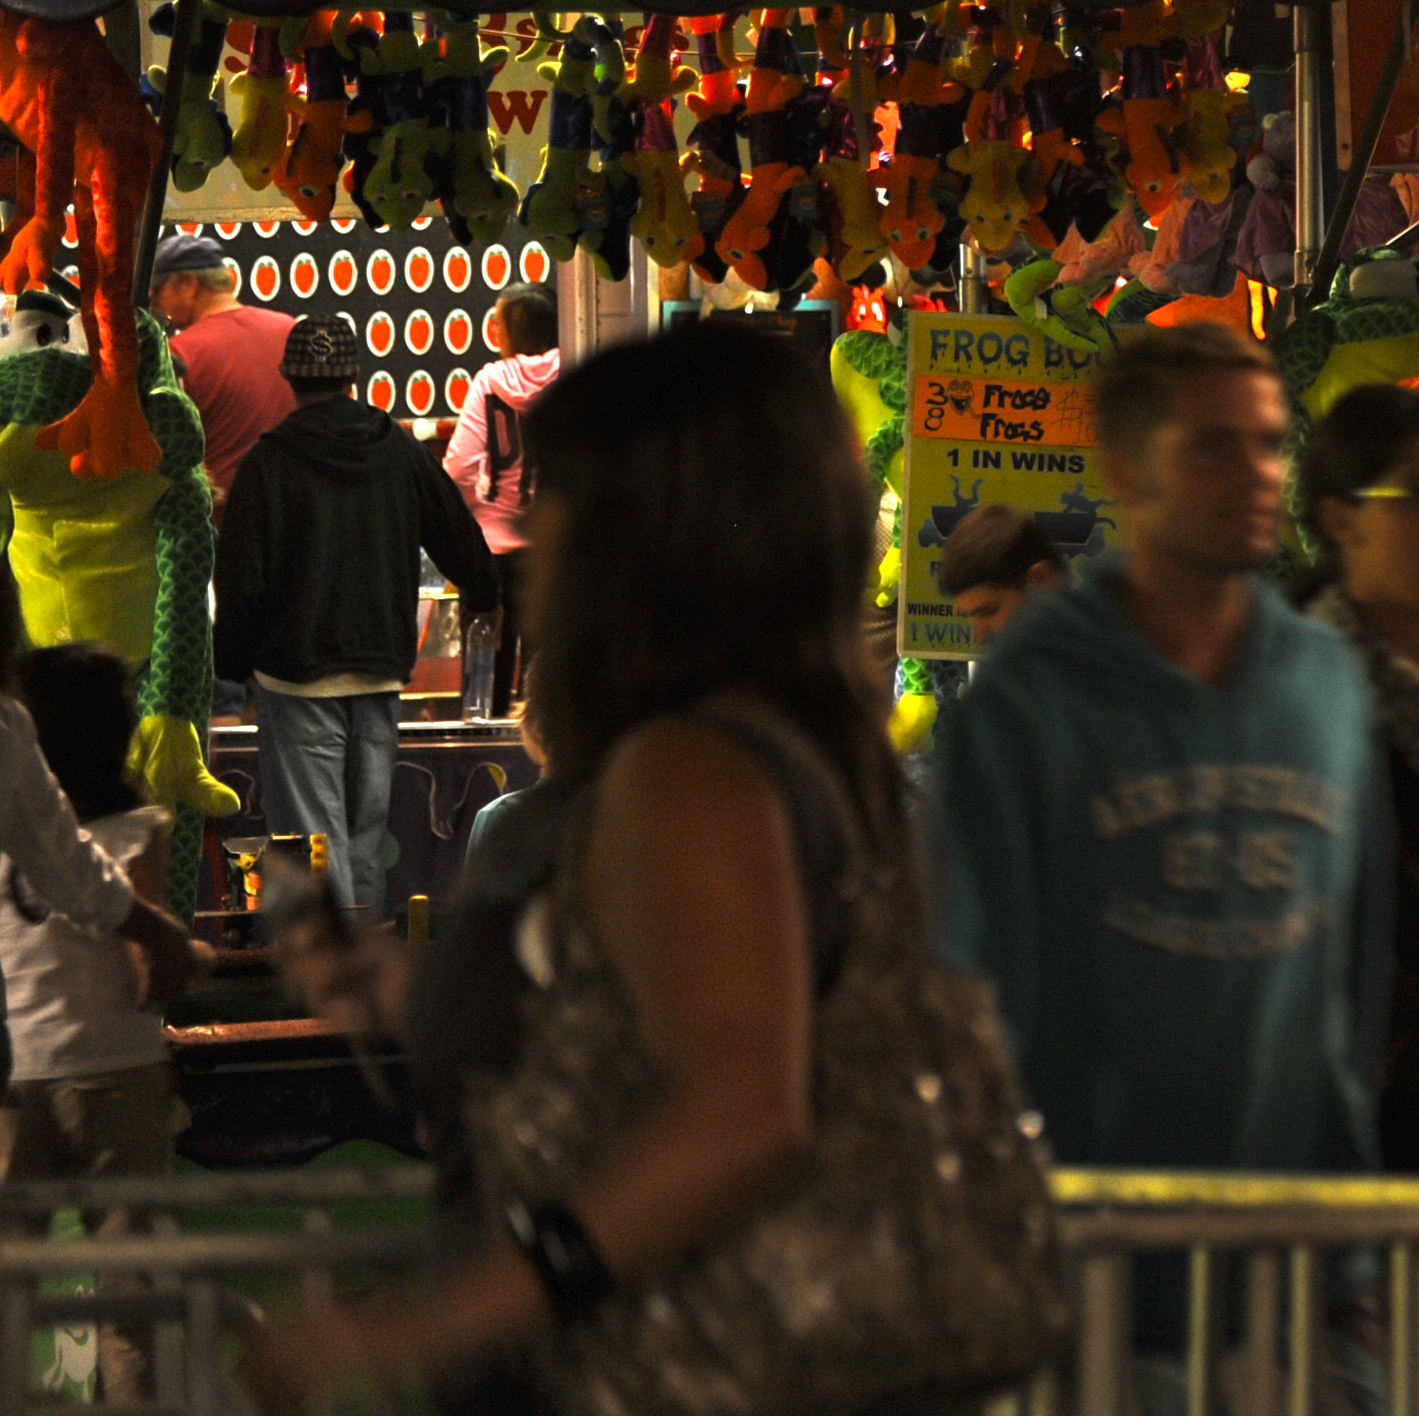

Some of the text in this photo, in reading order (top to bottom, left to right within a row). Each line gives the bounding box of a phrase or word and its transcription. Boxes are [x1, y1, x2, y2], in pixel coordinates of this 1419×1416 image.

[929, 329, 1031, 372] FROG
[926, 382, 948, 406] 3
[924, 407, 945, 431] 8
[947, 448, 1085, 473] 1 IN WINS
[907, 603, 953, 617] WINNER
